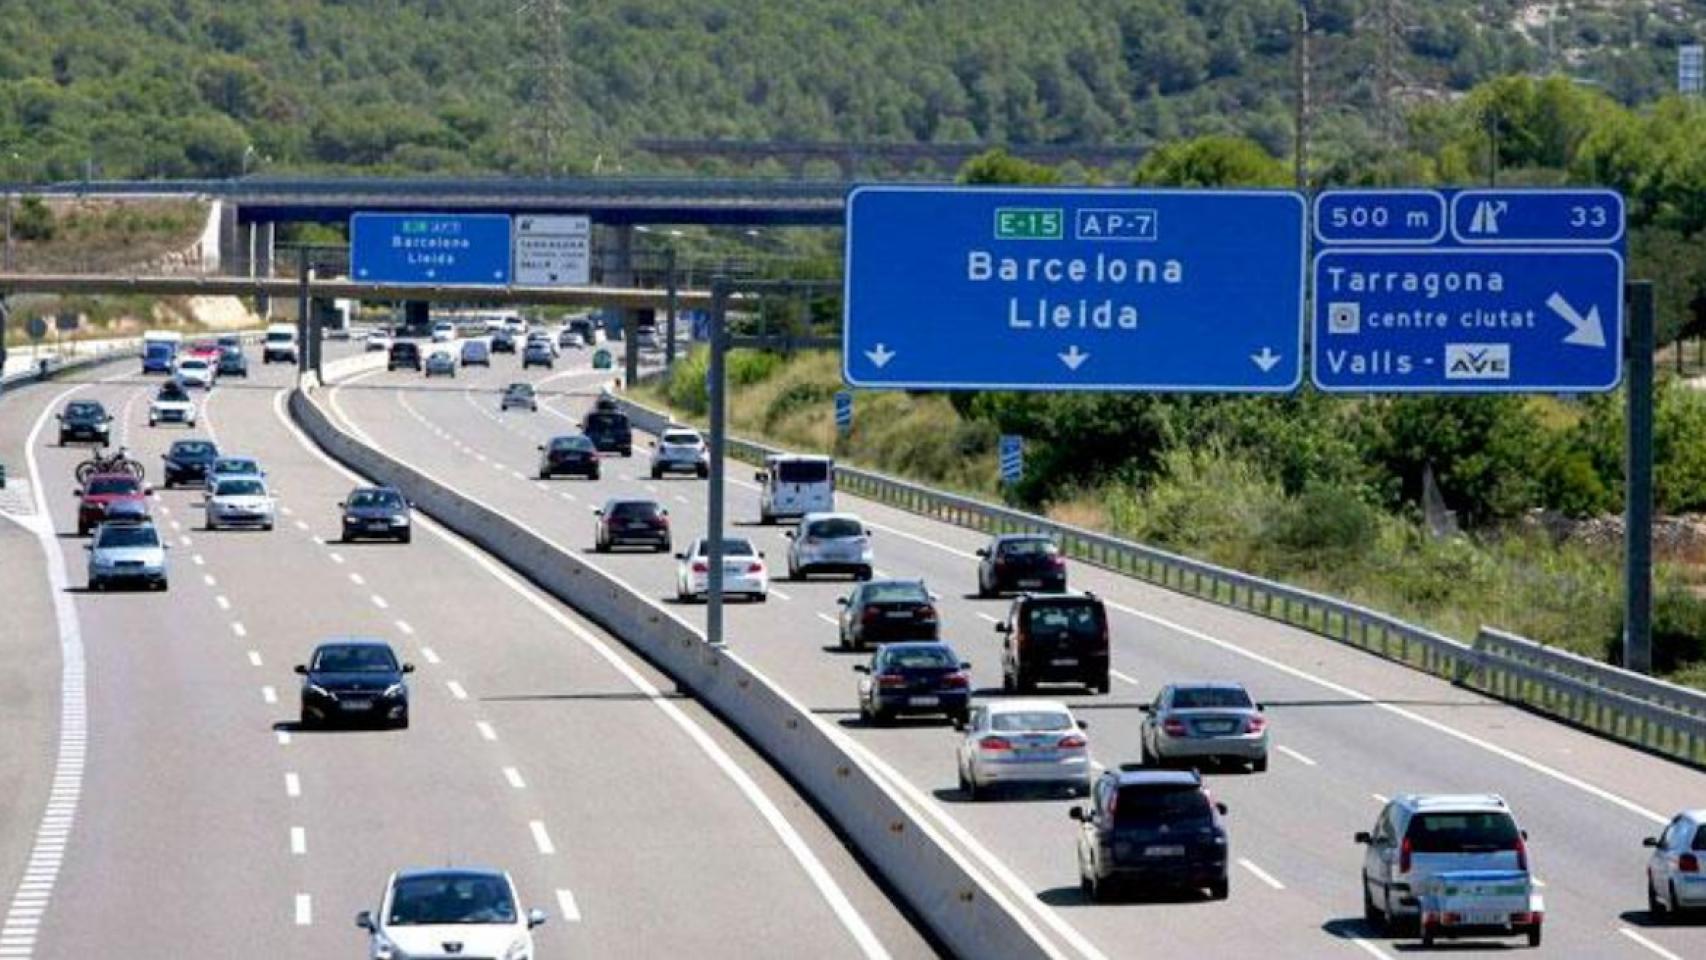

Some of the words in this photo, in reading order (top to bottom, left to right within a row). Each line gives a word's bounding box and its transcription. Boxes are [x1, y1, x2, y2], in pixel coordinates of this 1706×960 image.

[1001, 213, 1058, 234] E-15
[1083, 214, 1151, 235] AP-7
[1332, 207, 1388, 228] 500
[1406, 210, 1429, 227] m
[1570, 206, 1607, 228] 33
[968, 251, 1182, 283] Barcelona
[1327, 267, 1504, 299] Tarragona
[1009, 298, 1137, 329] Lleida
[1367, 311, 1448, 328] centre
[1460, 309, 1536, 328] ciutat
[1327, 350, 1413, 374] Valls
[1450, 353, 1506, 374] AVE
